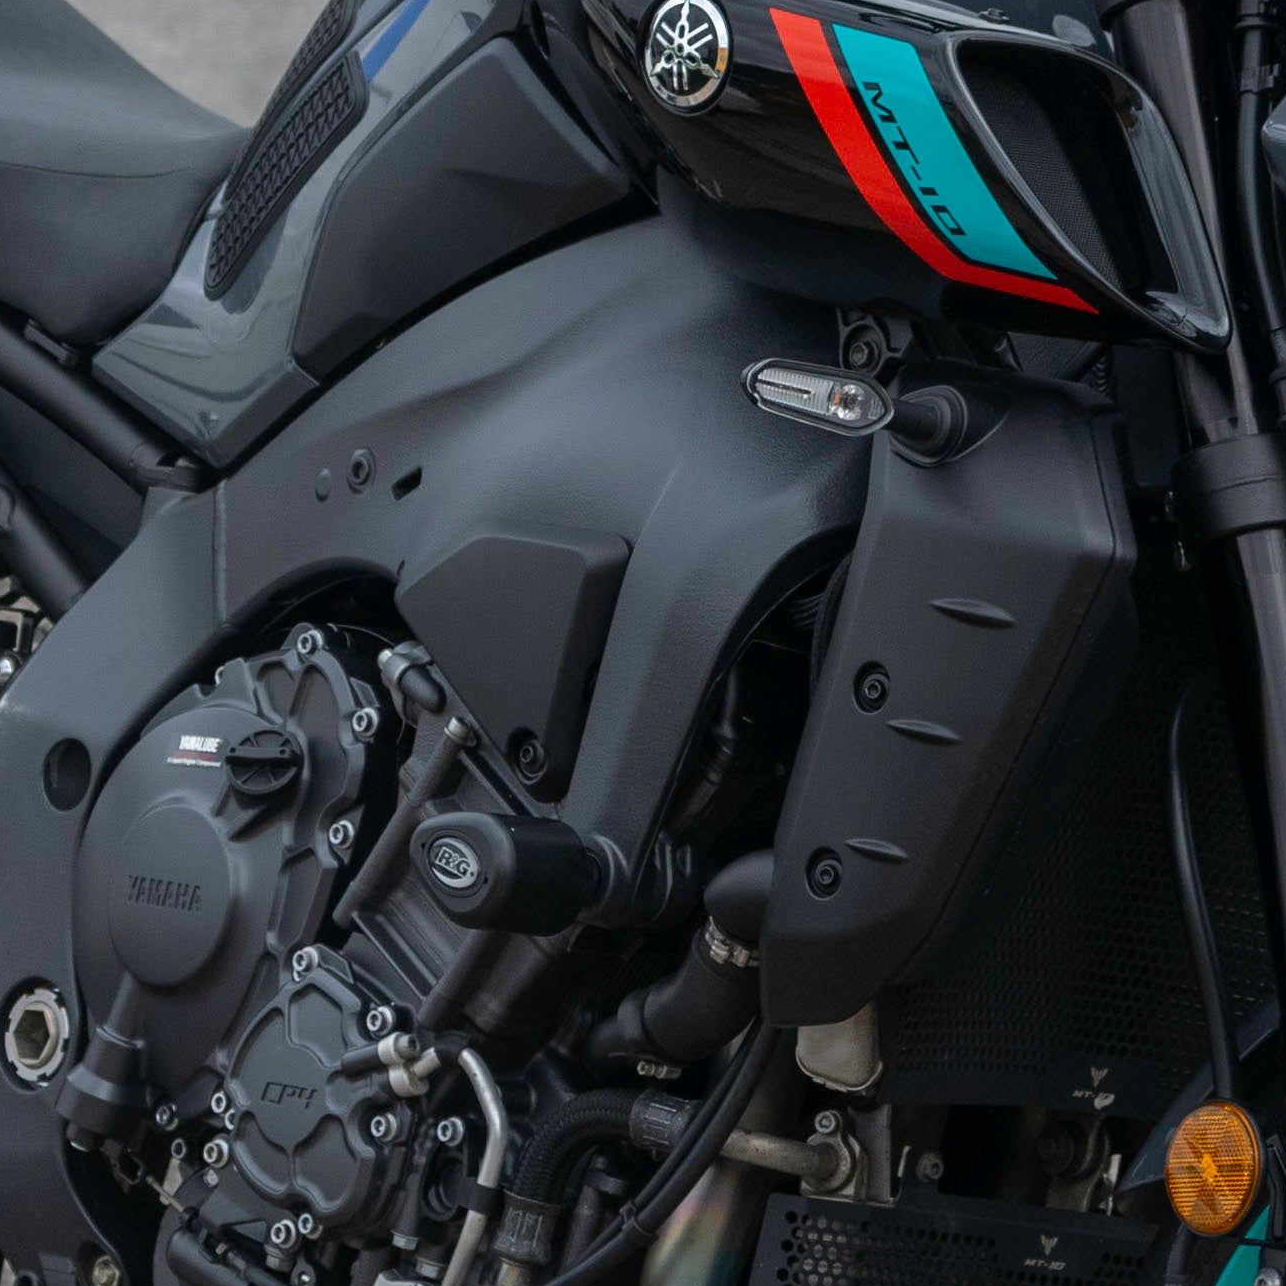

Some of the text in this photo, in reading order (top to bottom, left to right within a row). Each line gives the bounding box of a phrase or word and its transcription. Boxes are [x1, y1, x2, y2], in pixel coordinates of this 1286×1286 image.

[862, 81, 967, 236] MT-10
[435, 846, 472, 877] R&G
[126, 875, 201, 910] YAMAHA
